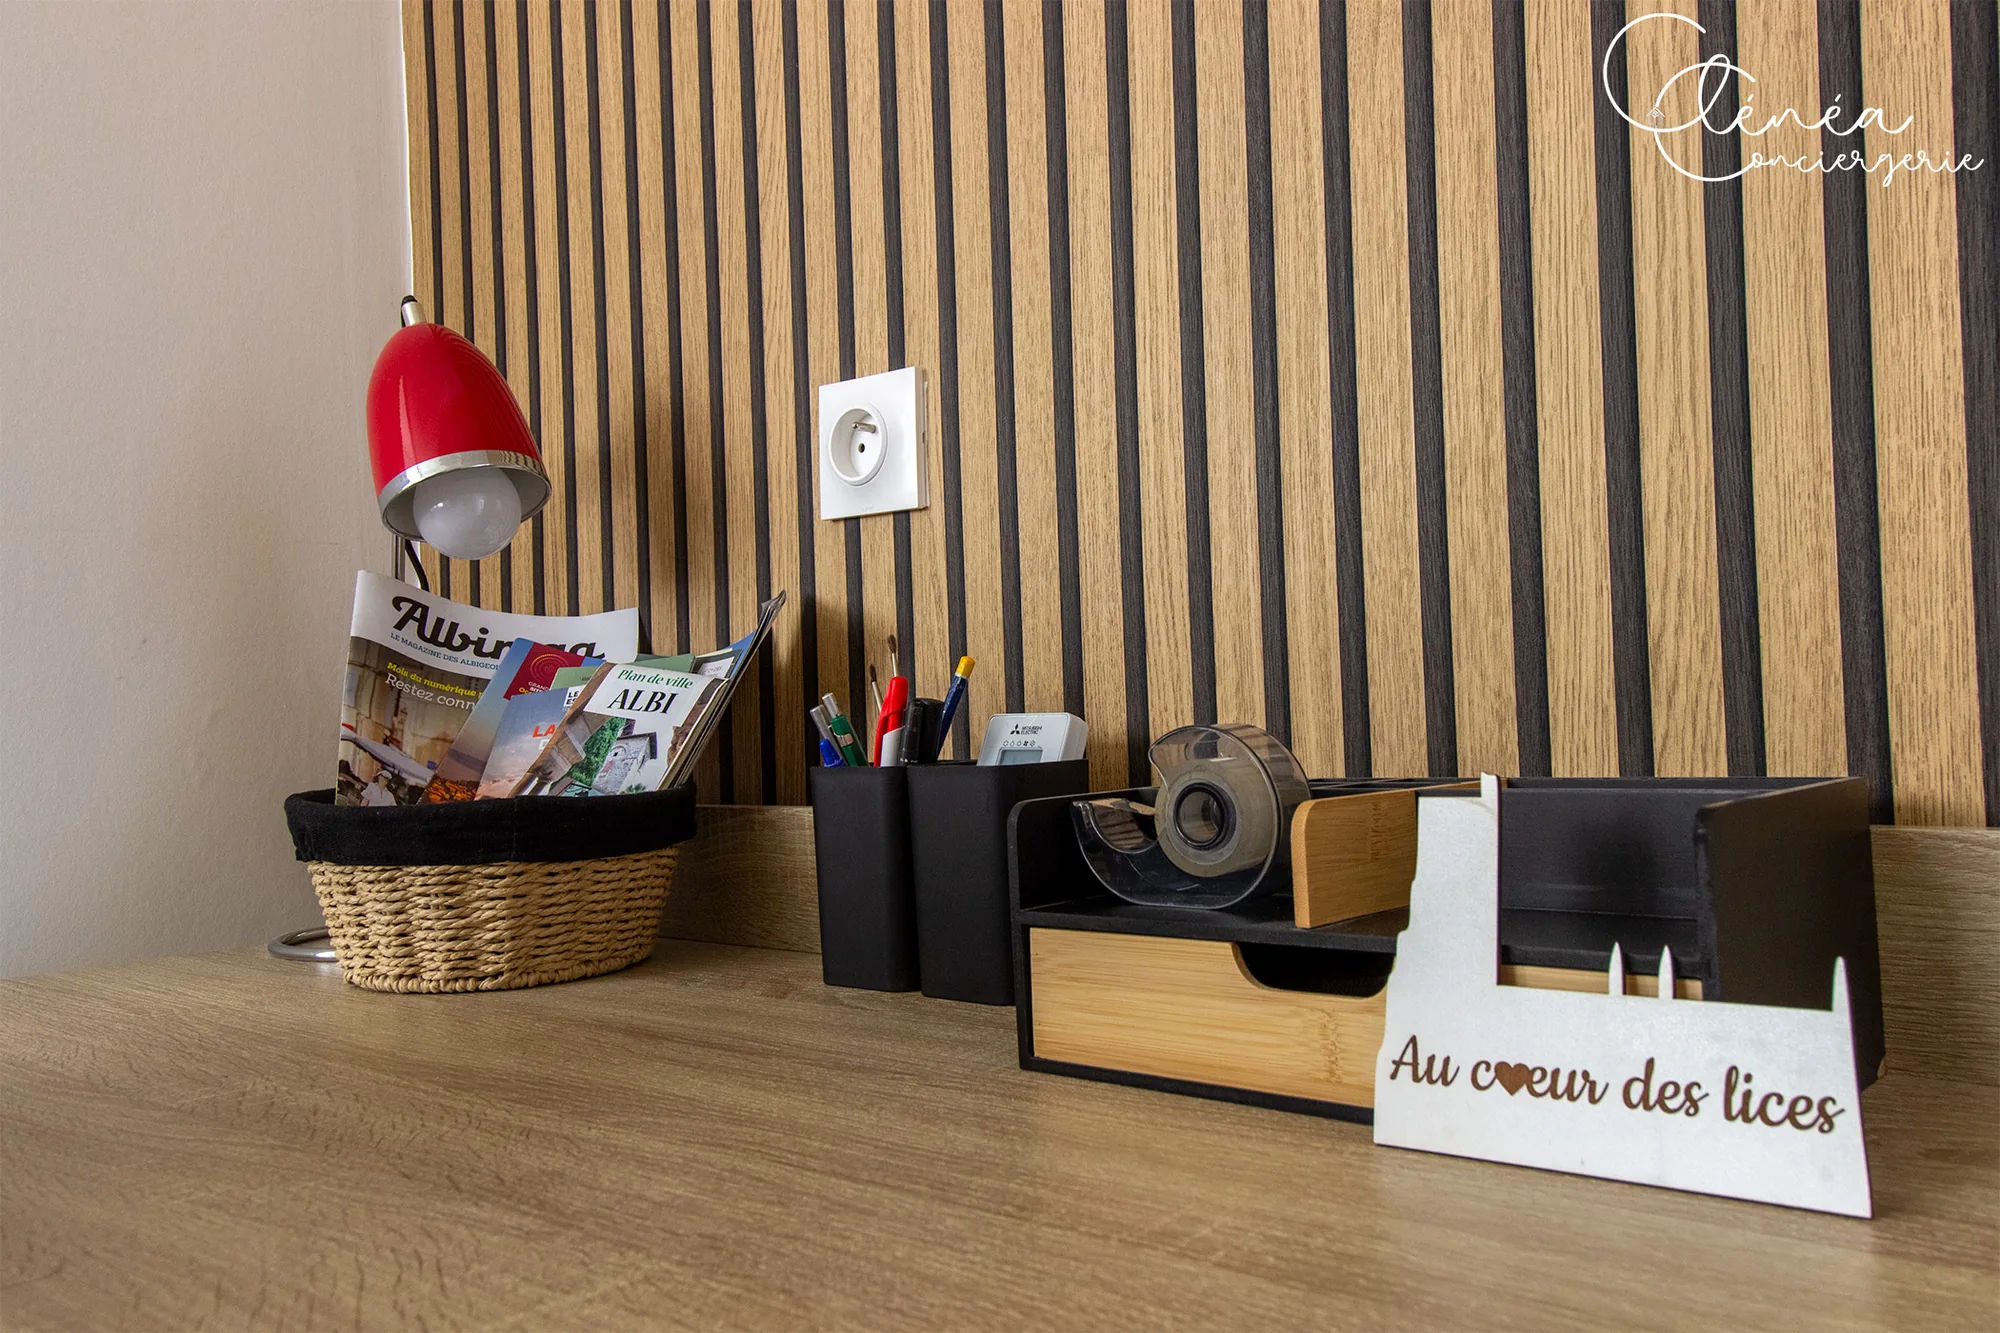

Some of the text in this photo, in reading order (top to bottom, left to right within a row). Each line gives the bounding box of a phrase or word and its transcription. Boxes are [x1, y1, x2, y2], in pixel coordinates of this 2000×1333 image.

[390, 632, 400, 642] LE
[401, 637, 442, 659] MAGAZINE
[443, 654, 459, 663] DES
[385, 672, 435, 702] Restez
[387, 661, 409, 677] Mois
[409, 672, 422, 684] du
[423, 679, 477, 697] numérique
[617, 669, 693, 689] Plan de ville
[607, 688, 679, 714] ALBI
[1389, 1034, 1460, 1087] Au
[1622, 1057, 1709, 1118] des
[1722, 1064, 1846, 1134] lices
